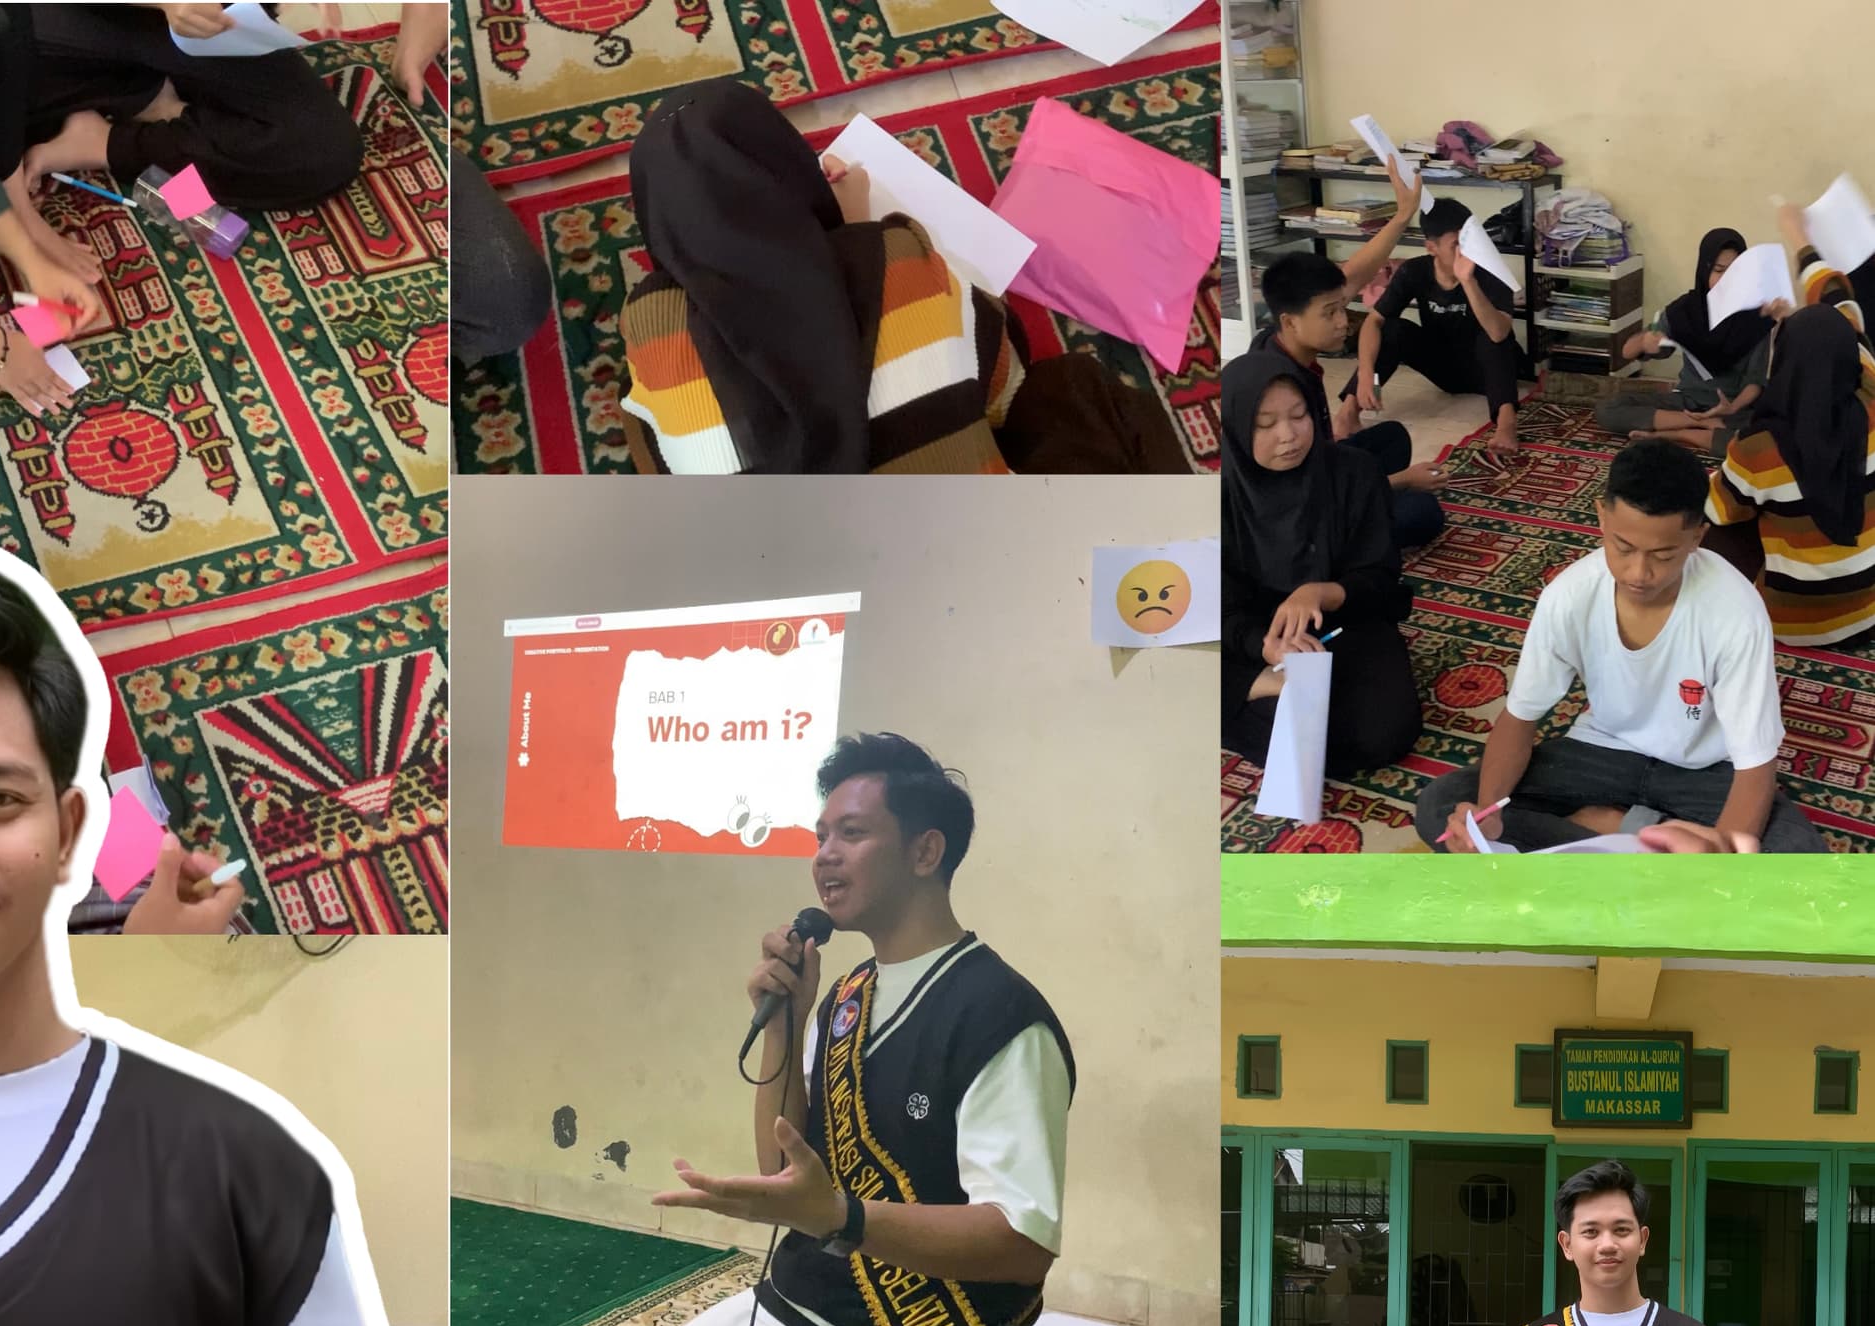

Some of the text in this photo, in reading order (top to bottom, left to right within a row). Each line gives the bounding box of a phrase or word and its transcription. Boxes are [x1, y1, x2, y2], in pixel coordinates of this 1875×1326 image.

[649, 690, 685, 704] BAB 1
[520, 691, 532, 748] About Me
[648, 708, 813, 743] Who am i?
[829, 1034, 854, 1088] DUTA
[1565, 1050, 1592, 1063] TAMAN
[1593, 1050, 1639, 1064] PENDIDIKAN
[1567, 1070, 1680, 1092] BUSTANUL ISLAMIYAH
[1585, 1099, 1661, 1114] MAKASSAR
